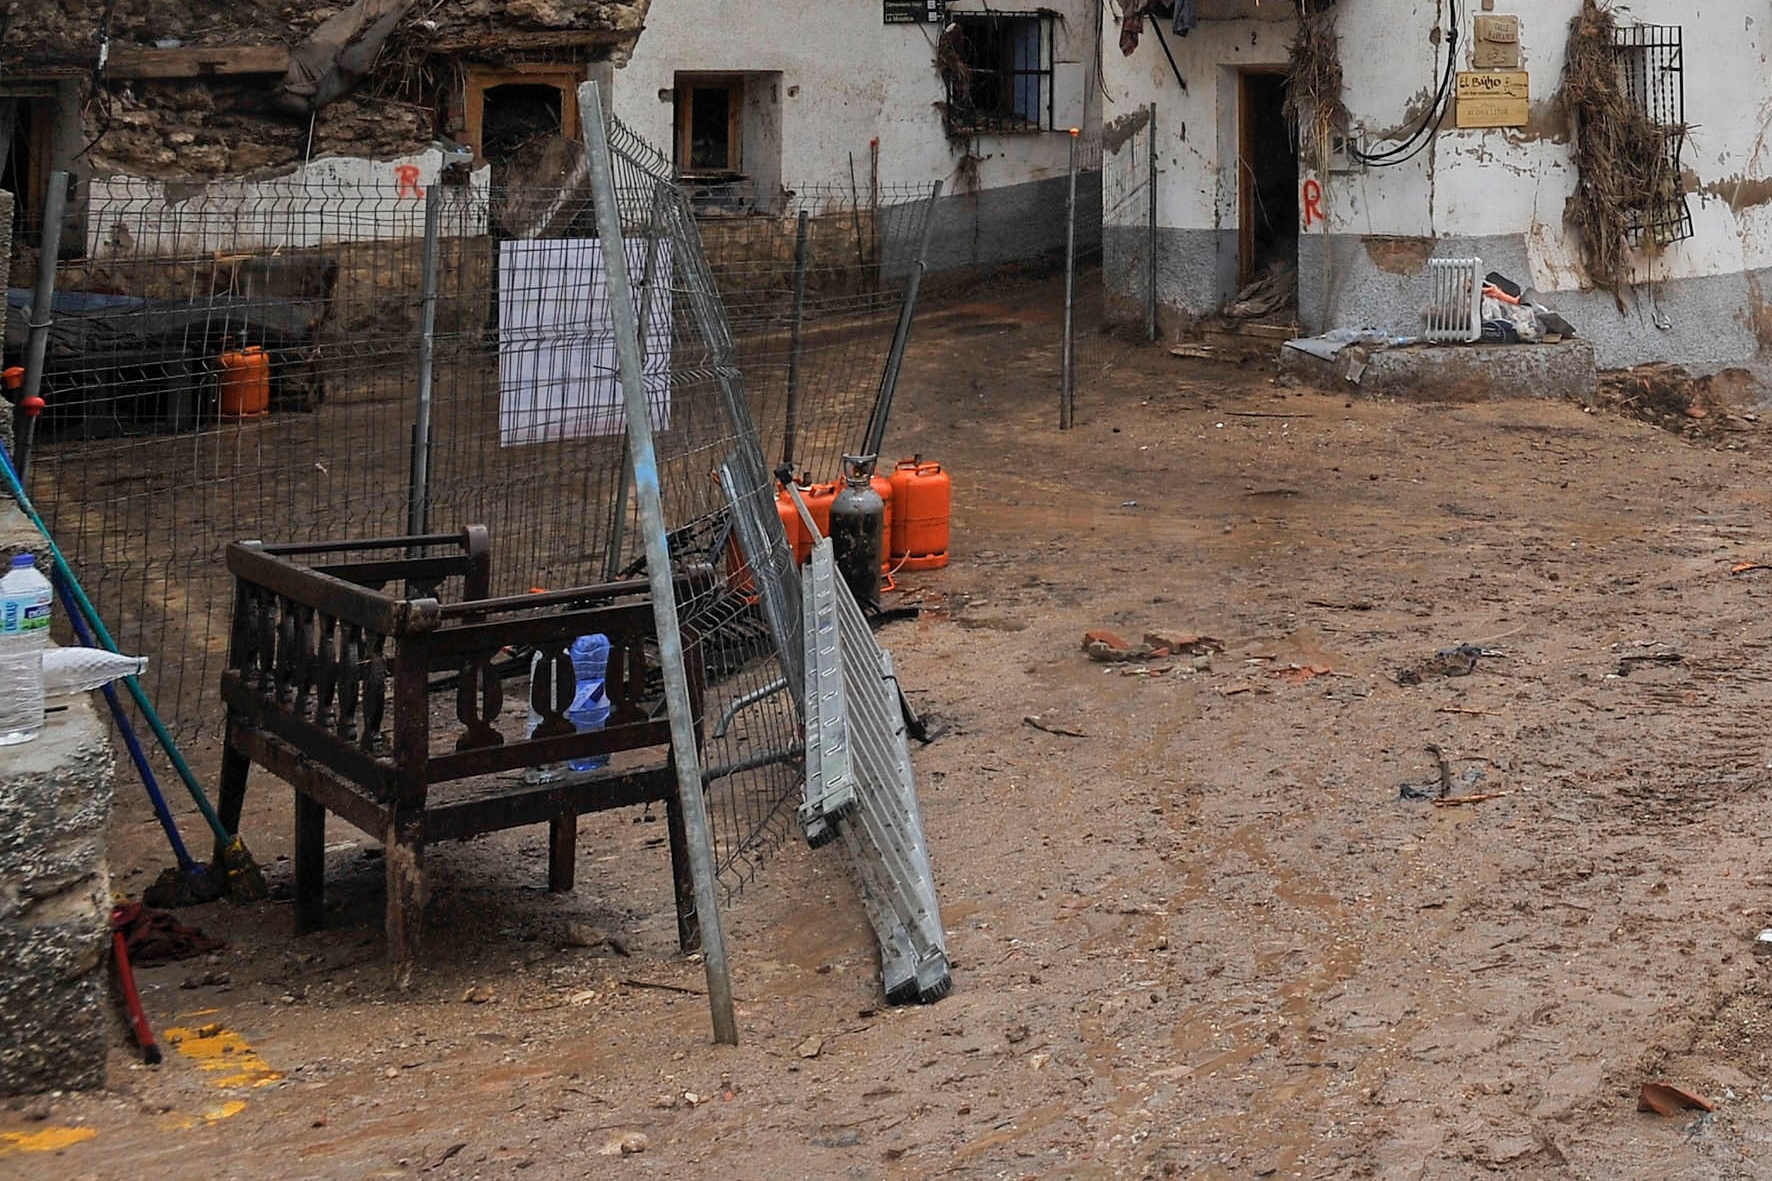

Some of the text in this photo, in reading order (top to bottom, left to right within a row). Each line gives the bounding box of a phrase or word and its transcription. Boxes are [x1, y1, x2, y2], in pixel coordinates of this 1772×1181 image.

[1251, 32, 1257, 45] 2
[395, 164, 425, 199] R
[1303, 179, 1325, 226] R
